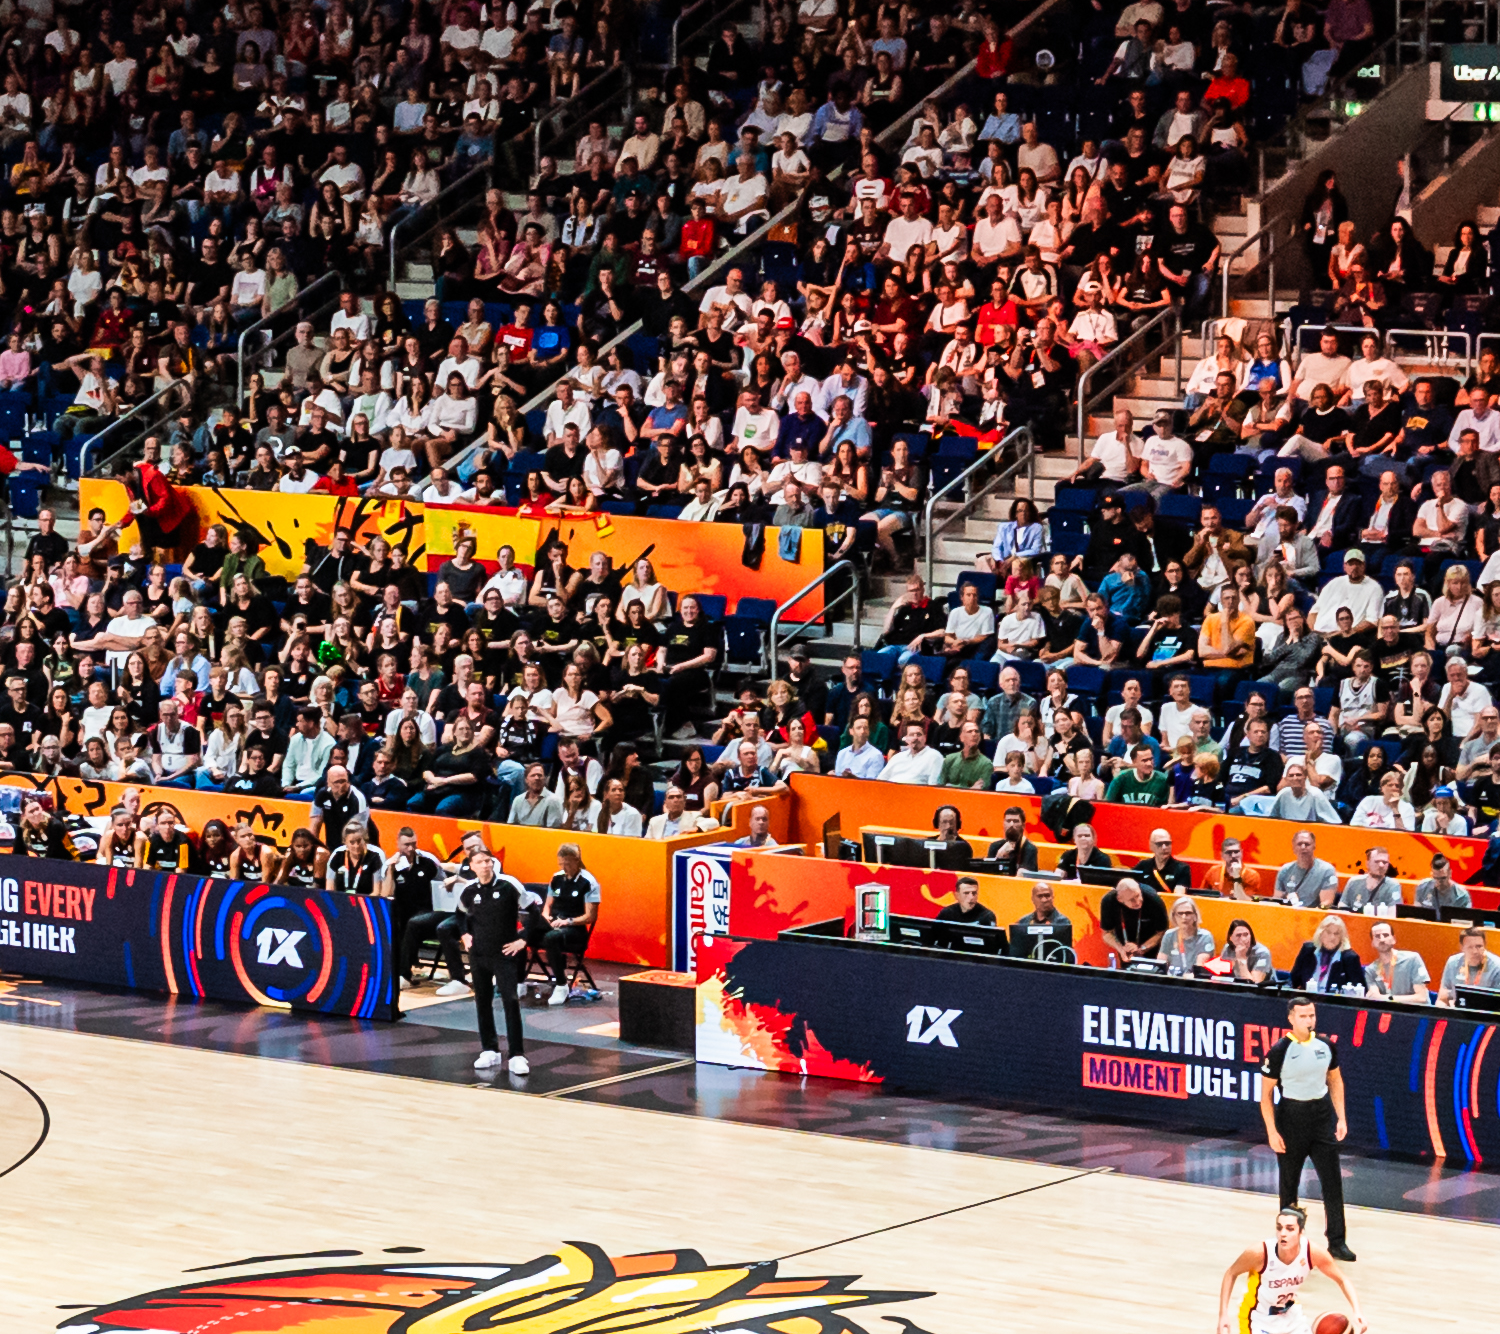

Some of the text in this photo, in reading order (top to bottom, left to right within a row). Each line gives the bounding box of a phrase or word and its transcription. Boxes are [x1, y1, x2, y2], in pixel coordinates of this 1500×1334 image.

[1454, 64, 1488, 81] Uber
[24, 880, 97, 921] EVERY
[257, 927, 307, 968] 1X
[906, 1005, 963, 1048] 1X
[1082, 1004, 1236, 1061] ELEVATING
[1089, 1057, 1182, 1094] MOMENT
